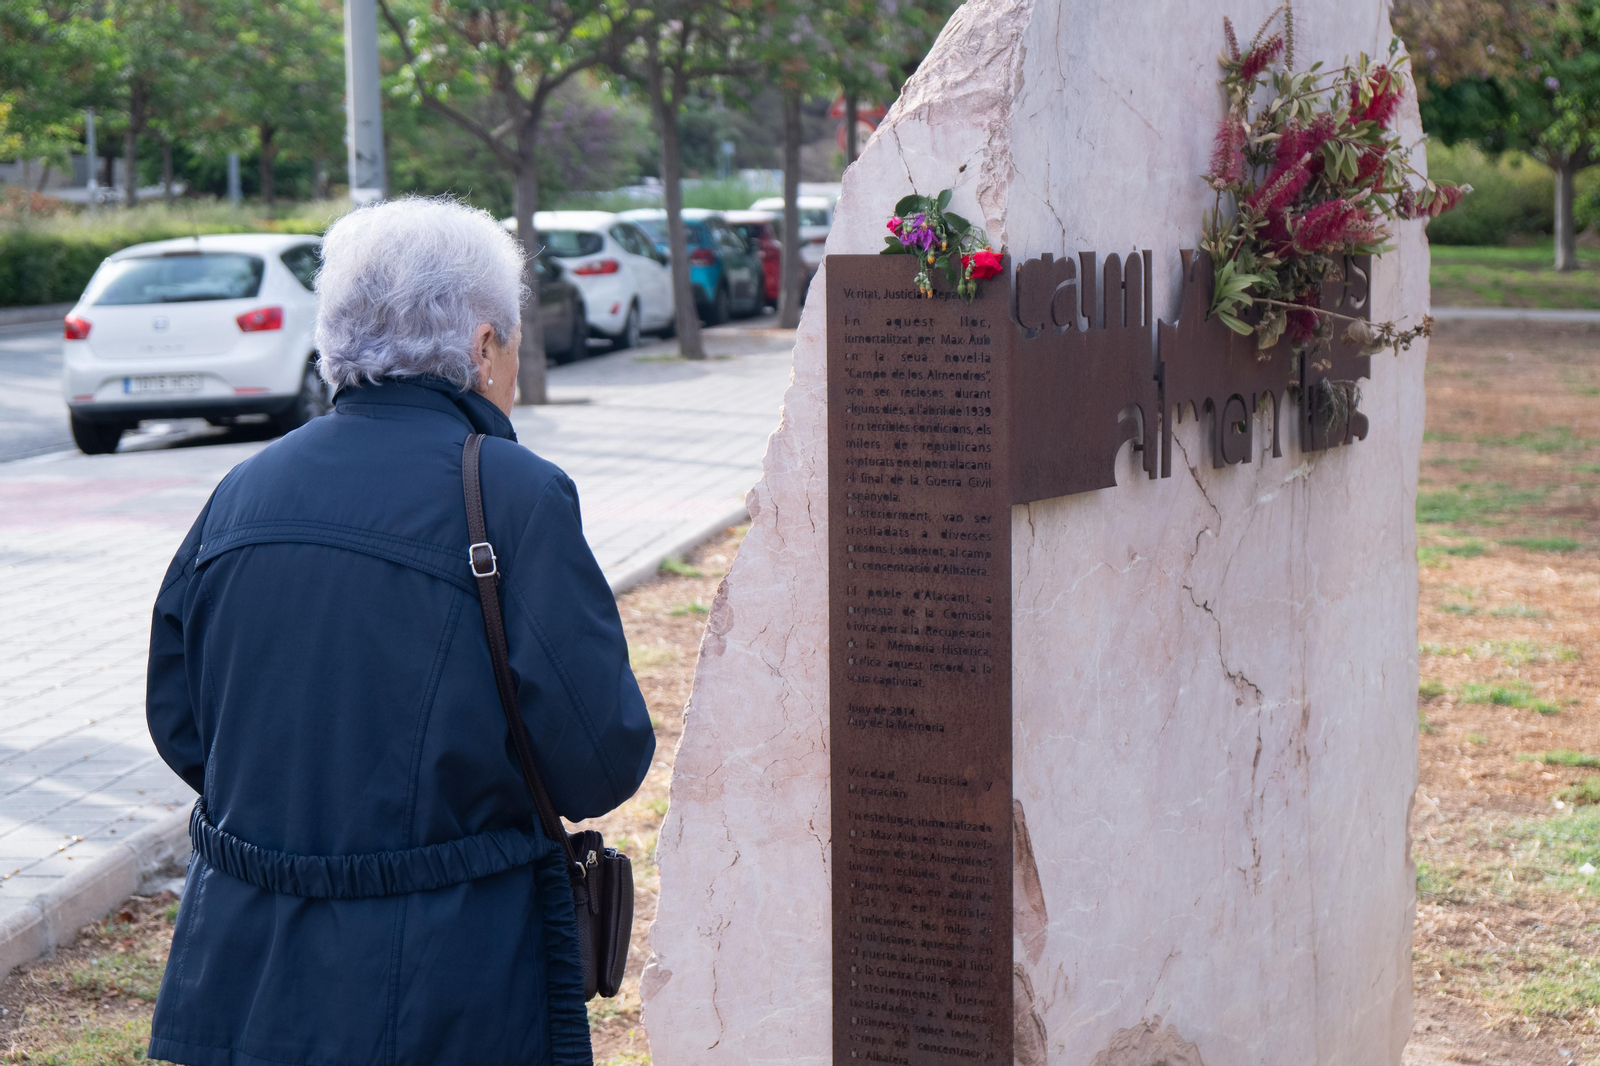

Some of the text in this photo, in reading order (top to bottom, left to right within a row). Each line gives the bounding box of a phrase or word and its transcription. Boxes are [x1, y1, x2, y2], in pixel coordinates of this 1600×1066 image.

[843, 288, 881, 300] Veritat,
[883, 288, 922, 300] Justícia
[844, 315, 992, 329] En aquest lloc,
[844, 333, 991, 346] inmortalitzat per Max Aub
[844, 353, 858, 361] en
[874, 350, 885, 361] la
[901, 353, 928, 362] seua
[891, 369, 905, 380] de
[908, 369, 923, 380] los
[845, 386, 991, 399] van ser reclosos durant
[845, 402, 880, 416] alguns
[882, 402, 907, 416] dies,
[948, 405, 962, 416] de
[965, 406, 992, 416] 1939
[851, 423, 864, 431] en
[867, 422, 910, 433] terribles
[913, 424, 974, 435] condicions,
[976, 425, 992, 435] els
[845, 438, 992, 453] milers de republicans
[846, 458, 895, 468] capturats
[897, 459, 910, 467] en
[924, 460, 947, 470] port
[949, 459, 992, 470] alacantí
[861, 473, 884, 483] final
[890, 474, 904, 484] de
[925, 476, 962, 487] Guerra
[968, 477, 992, 488] Civil
[846, 492, 901, 504] espanyola.
[846, 506, 992, 524] Posteriorment, van ser
[846, 526, 910, 537] traslladats
[940, 529, 992, 541] diverses
[898, 546, 946, 558] sobretot,
[961, 550, 992, 561] camp
[846, 559, 858, 570] de
[862, 561, 930, 573] concentració
[846, 586, 857, 596] El
[867, 588, 903, 600] poble
[846, 606, 893, 617] proposta
[902, 606, 916, 617] de
[943, 609, 993, 621] Comissió
[880, 625, 898, 635] per
[925, 626, 992, 639] Recuperació
[846, 638, 859, 648] de
[846, 655, 881, 667] dedica
[887, 660, 923, 671] aquest
[929, 662, 964, 673] record
[847, 675, 926, 689] seua captivitat.
[847, 703, 915, 717] Juny de 2014
[847, 717, 868, 728] Any
[870, 718, 884, 728] de
[847, 766, 899, 782] Verdad,
[915, 773, 969, 787] Justicia
[848, 783, 906, 799] Reparación
[864, 813, 885, 822] este
[887, 813, 916, 827] lugar,
[918, 816, 992, 833] inmortalizado
[849, 829, 993, 851] por Max Aub en su novela
[893, 848, 907, 860] de
[910, 850, 926, 861] los
[849, 860, 993, 886] fueron recluidos durante
[850, 878, 890, 893] algunos
[927, 889, 941, 897] en
[948, 889, 972, 901] abril
[978, 891, 993, 904] de
[850, 895, 878, 908] 1939
[911, 905, 926, 913] en
[941, 906, 993, 921] terribles
[921, 920, 936, 932] los
[943, 924, 972, 936] miles
[979, 926, 992, 937] de
[849, 932, 993, 955] republicanos apresados en
[862, 948, 898, 961] puerto
[901, 954, 953, 968] alicantino
[970, 960, 993, 973] final
[850, 963, 863, 974] de
[876, 967, 912, 981] Guerra
[914, 972, 937, 983] Civil
[954, 993, 994, 1007] fueron
[850, 998, 916, 1016] trasladados
[946, 1009, 994, 1025] diversas
[849, 1016, 897, 1030] prisiones
[915, 1024, 945, 1036] sobre
[950, 1029, 979, 1042] todo,
[850, 1033, 994, 1060] campo de concentración
[850, 1048, 863, 1059] de
